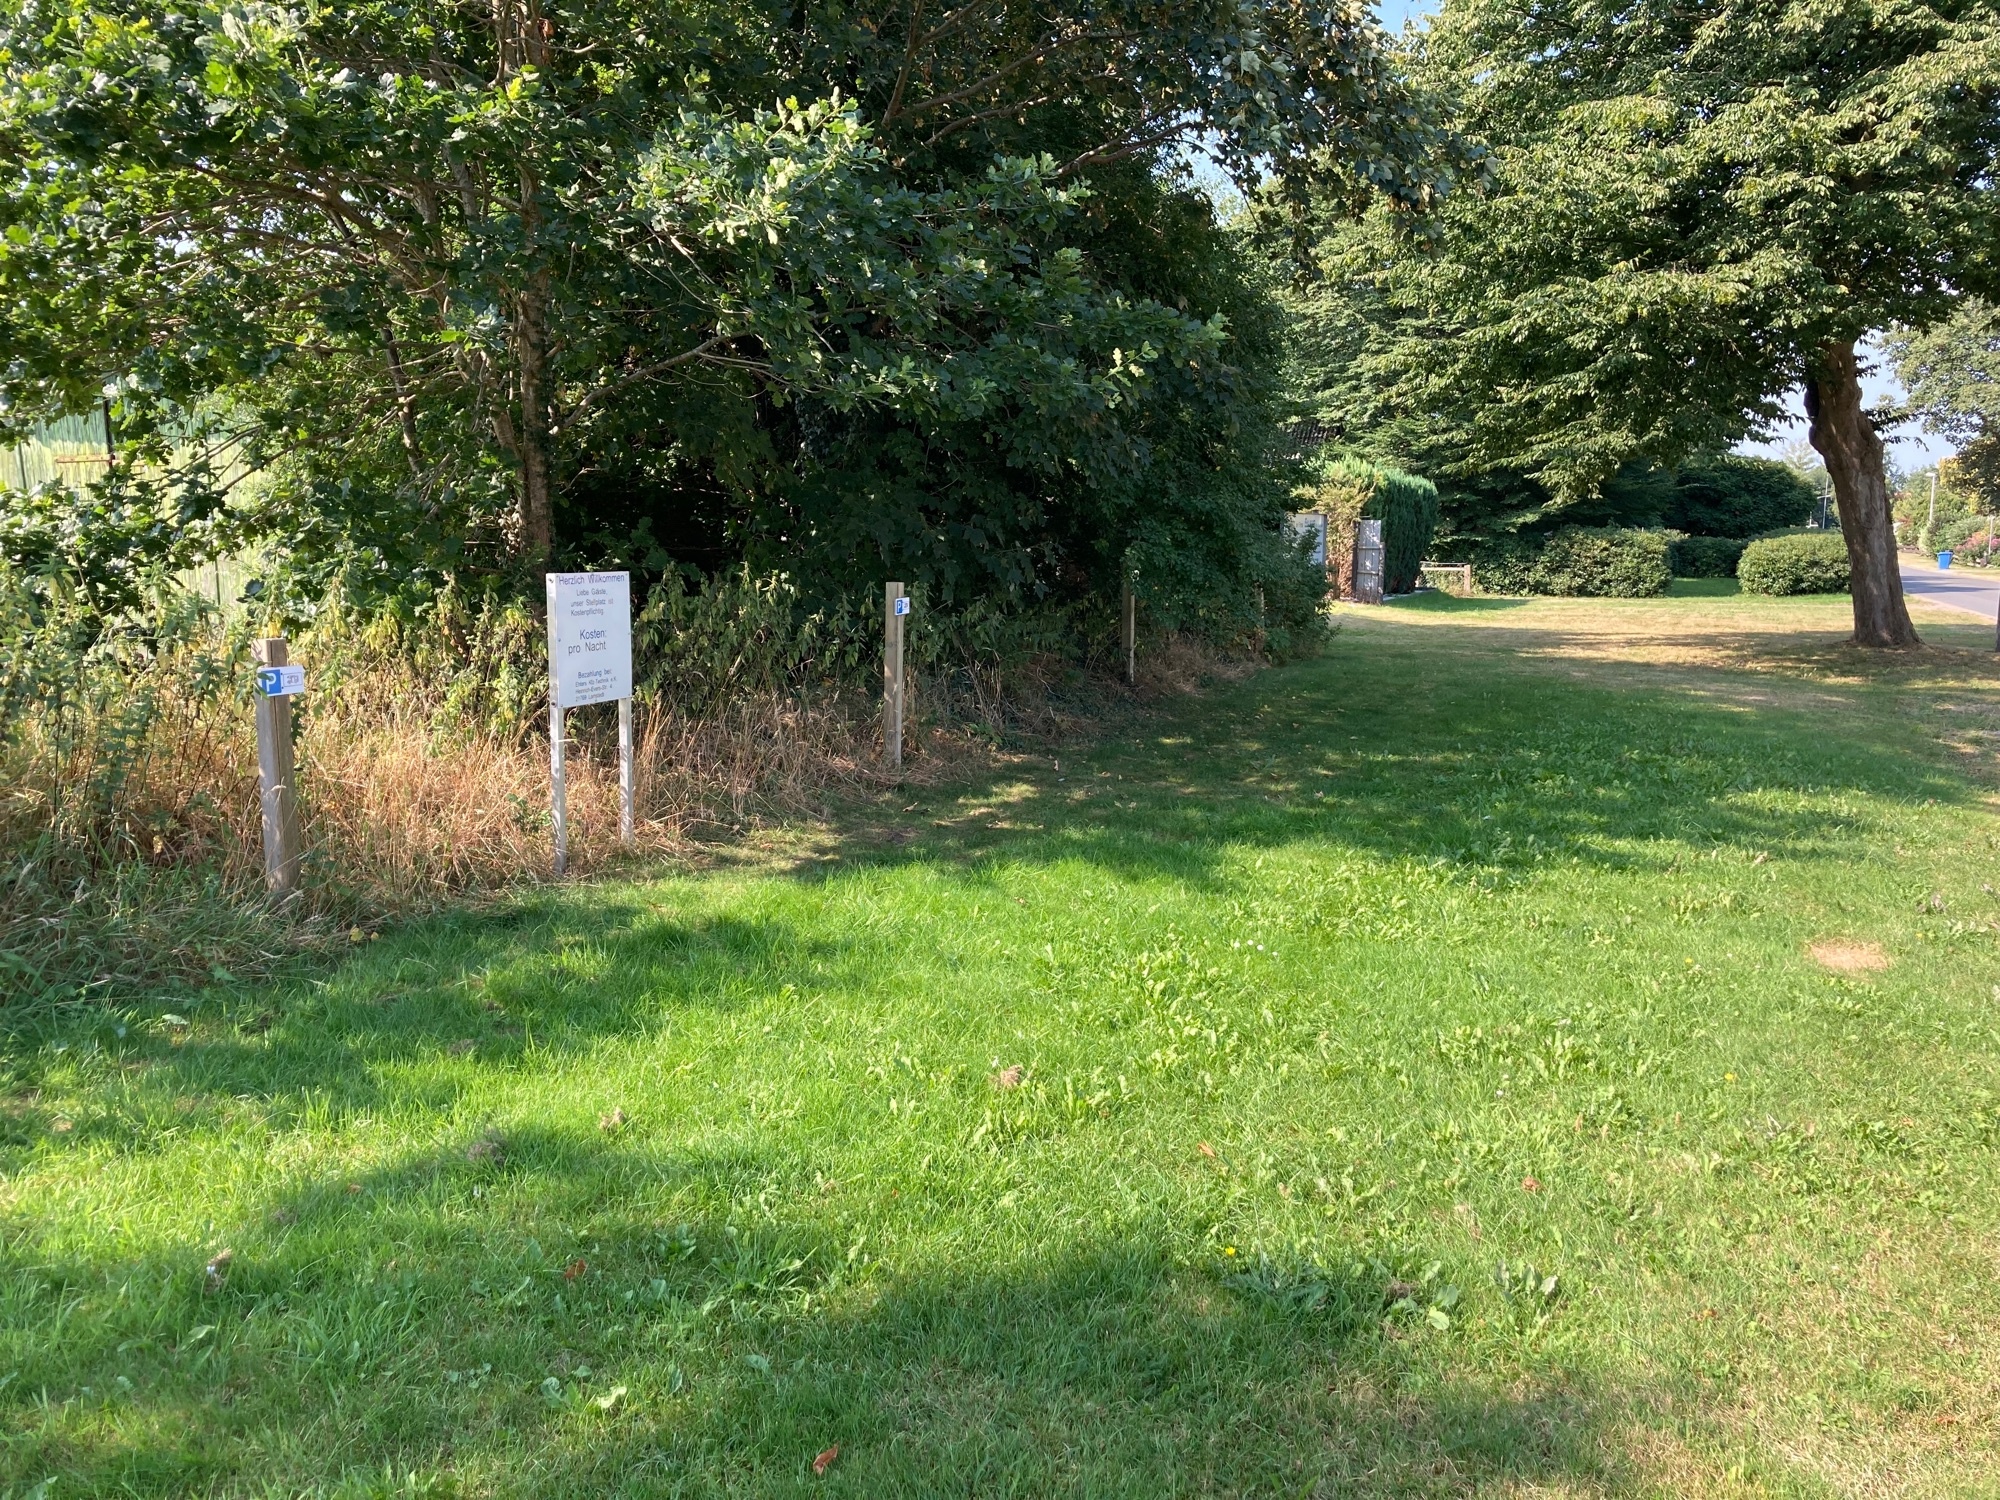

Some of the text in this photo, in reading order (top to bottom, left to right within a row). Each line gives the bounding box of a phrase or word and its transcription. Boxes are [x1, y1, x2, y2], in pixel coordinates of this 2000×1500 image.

[558, 574, 625, 585] Herzlich Willkommen
[580, 629, 607, 640] Kosten:
[568, 641, 606, 656] pro Nacht
[578, 670, 602, 678] Bezahlung
[265, 672, 276, 692] P
